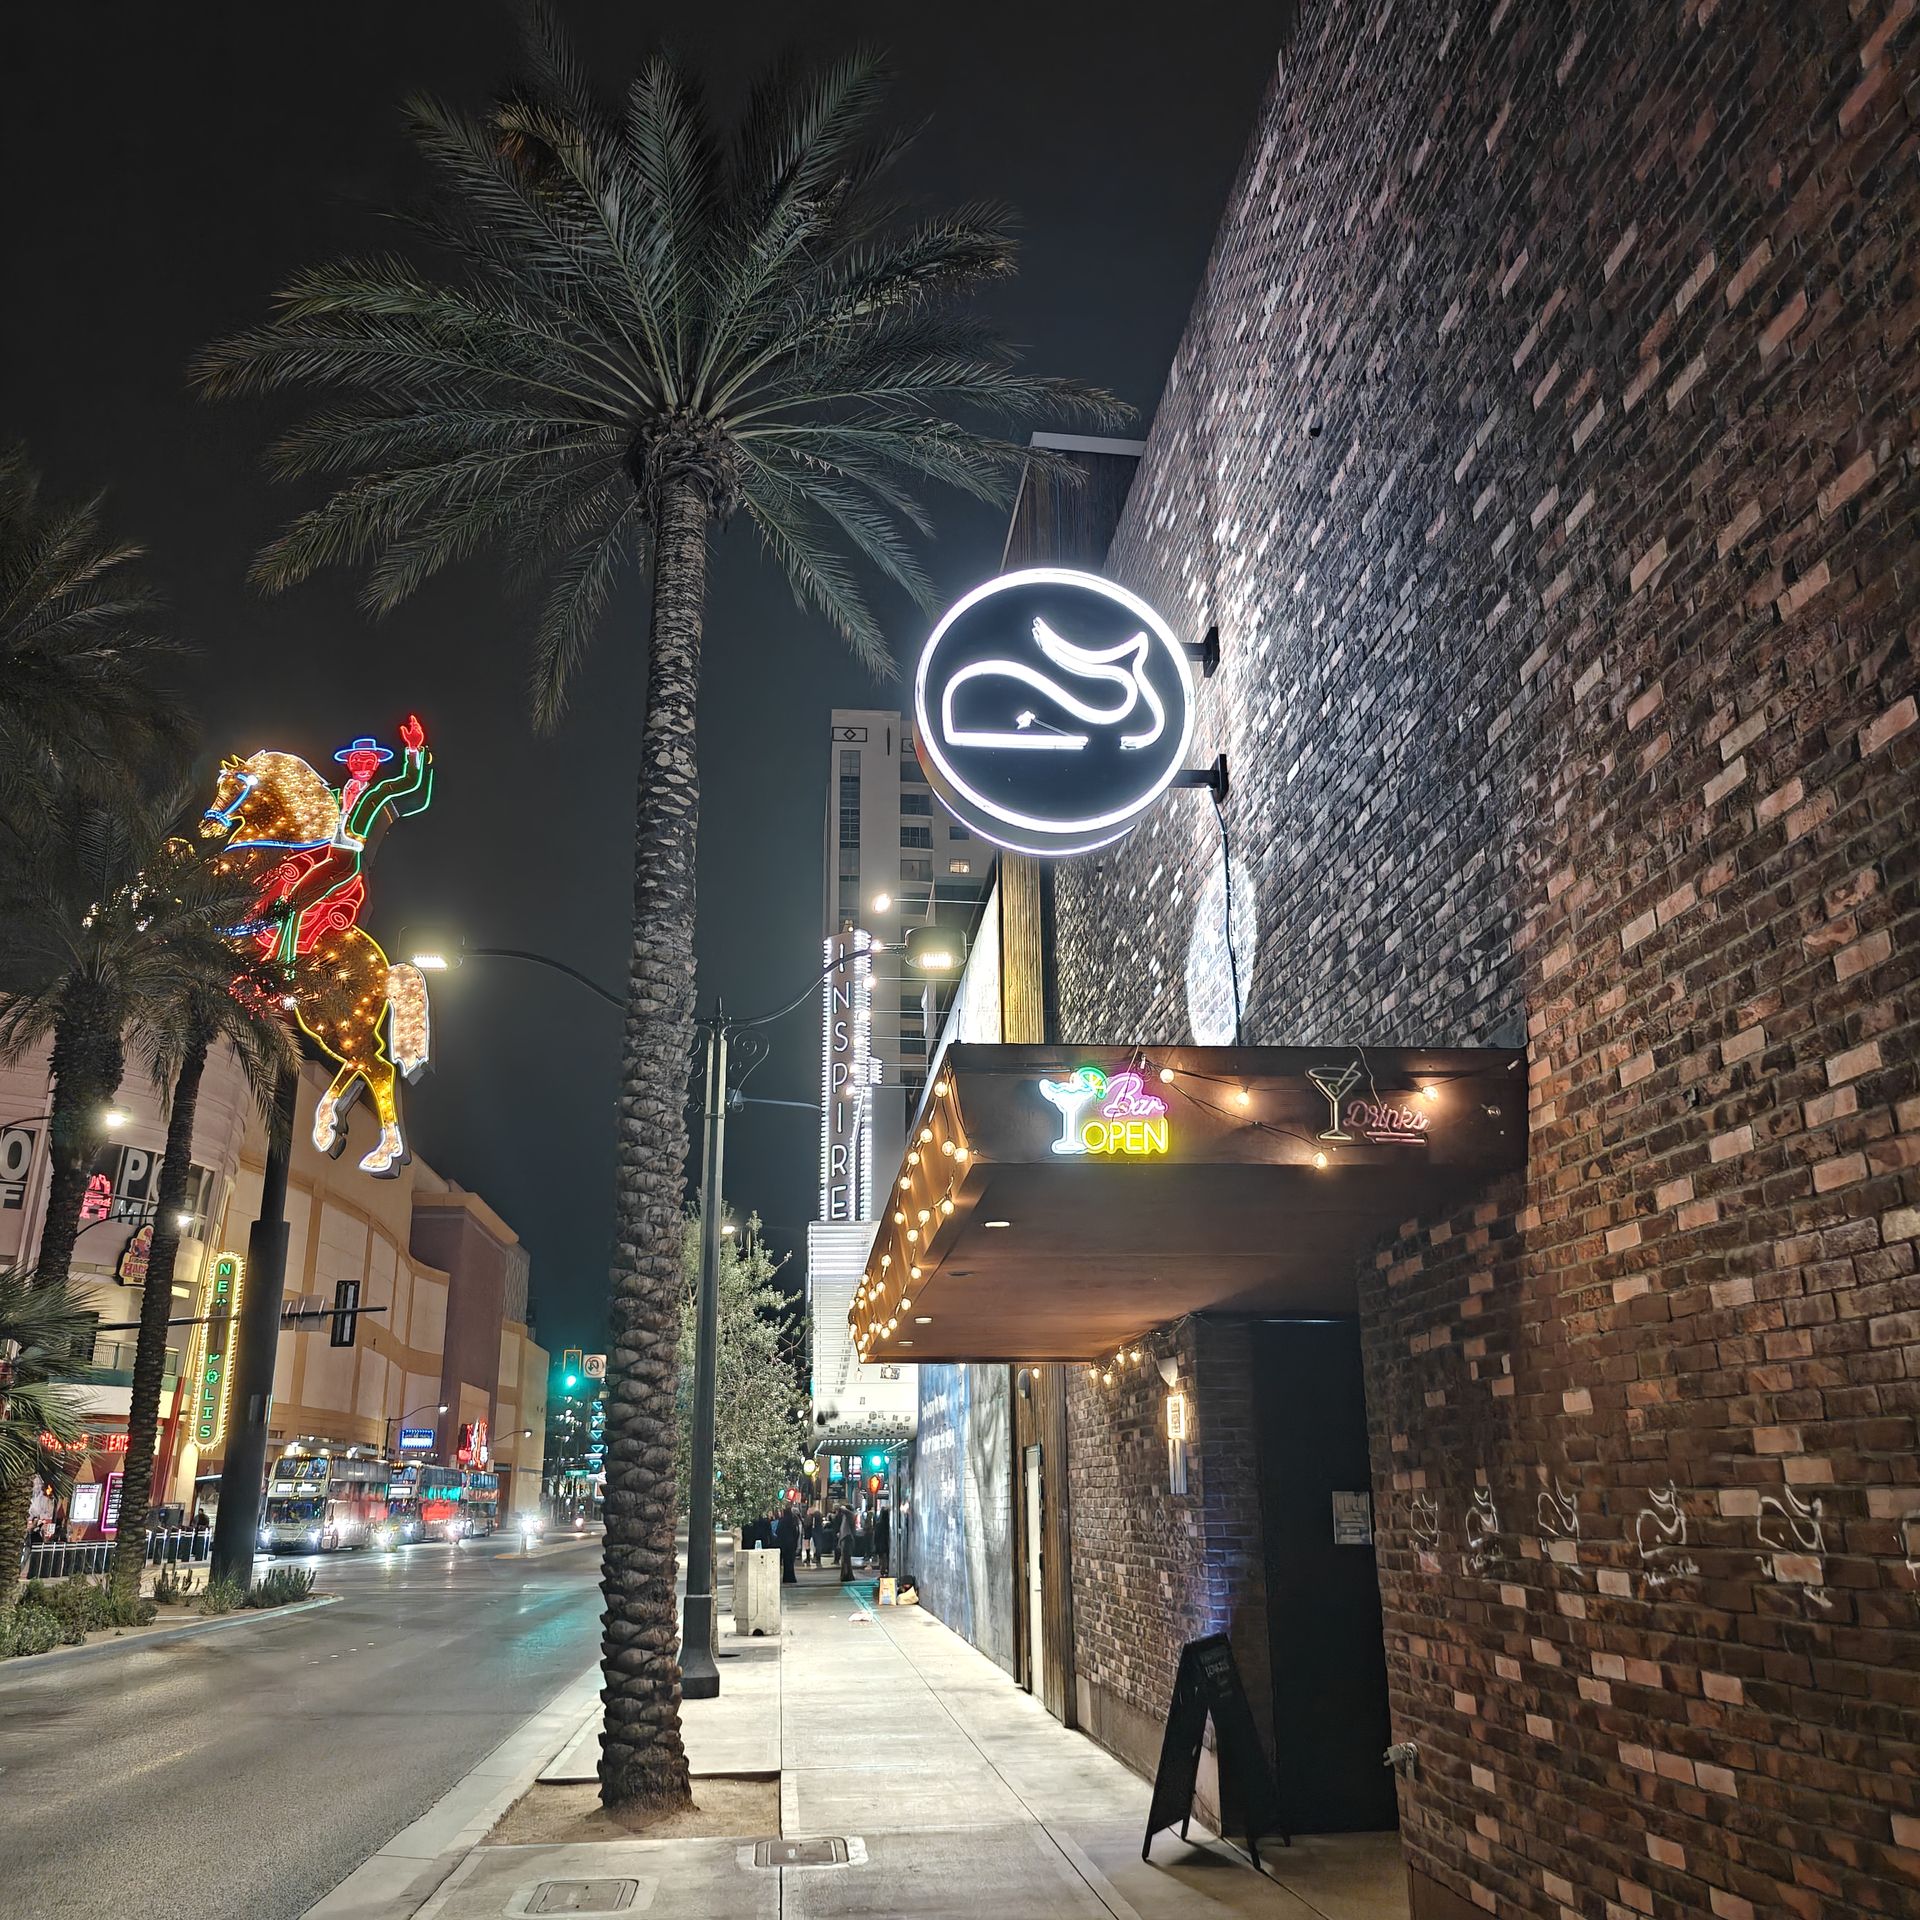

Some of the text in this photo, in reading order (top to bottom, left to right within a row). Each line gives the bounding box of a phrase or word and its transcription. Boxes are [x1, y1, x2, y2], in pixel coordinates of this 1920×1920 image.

[831, 943, 850, 1219] INSPIRE
[1103, 1072, 1166, 1118] Bar
[1343, 1100, 1430, 1130] Drinks
[1082, 1121, 1168, 1152] OPEN
